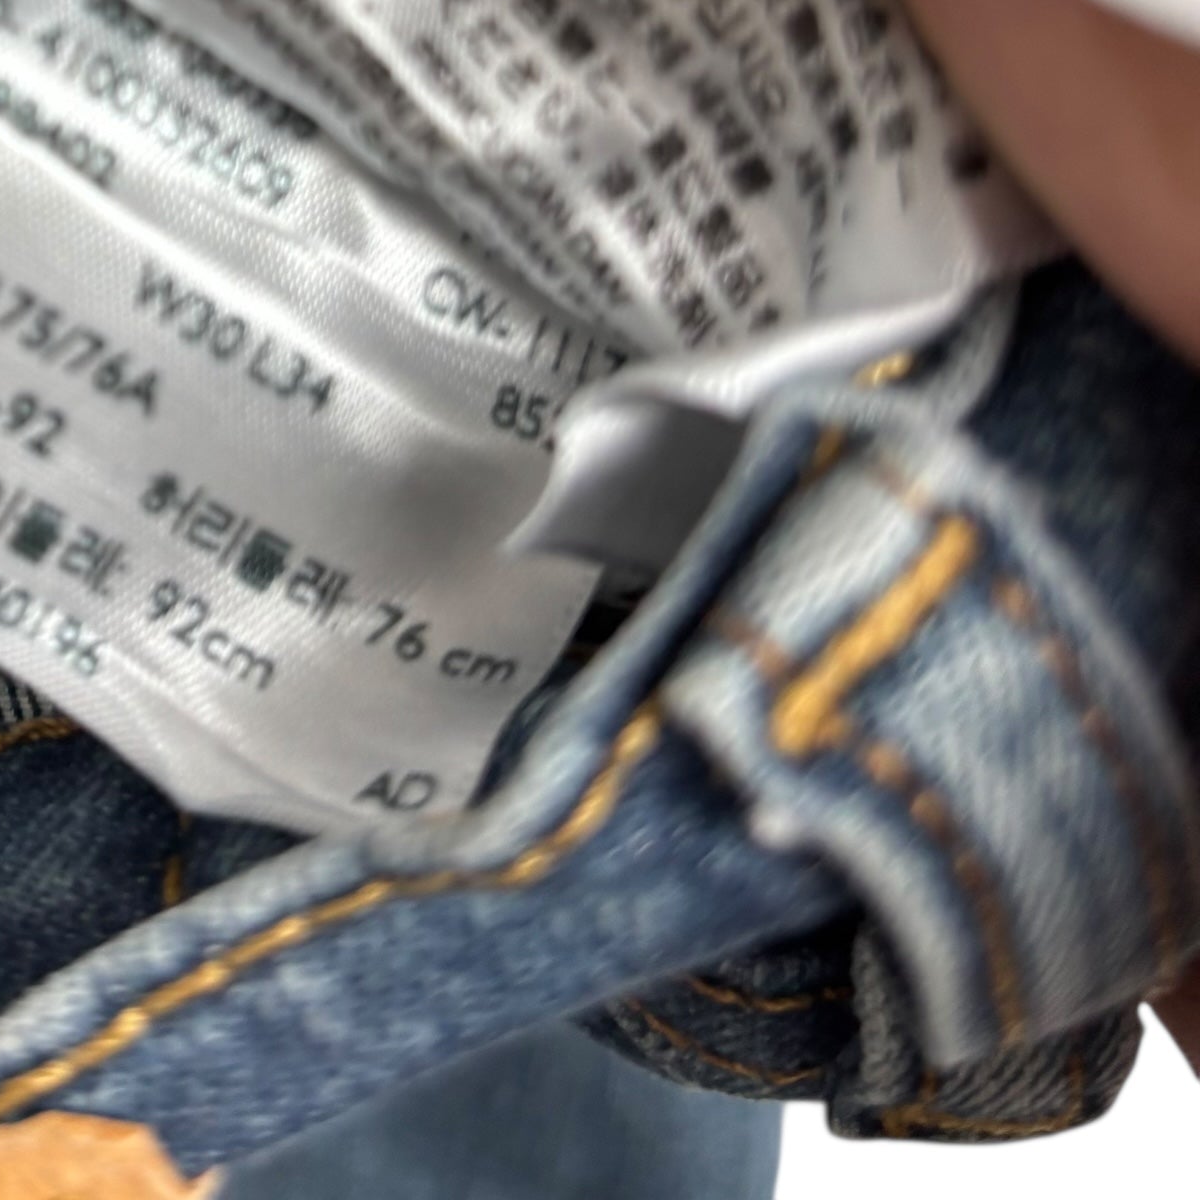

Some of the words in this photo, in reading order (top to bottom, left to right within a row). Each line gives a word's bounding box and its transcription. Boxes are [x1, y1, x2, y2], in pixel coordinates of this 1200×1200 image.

[135, 260, 246, 360] W30
[248, 336, 336, 416] L34
[489, 384, 562, 452] 85
[364, 601, 431, 663] 76
[438, 647, 519, 682] cm
[353, 767, 439, 811] AD
